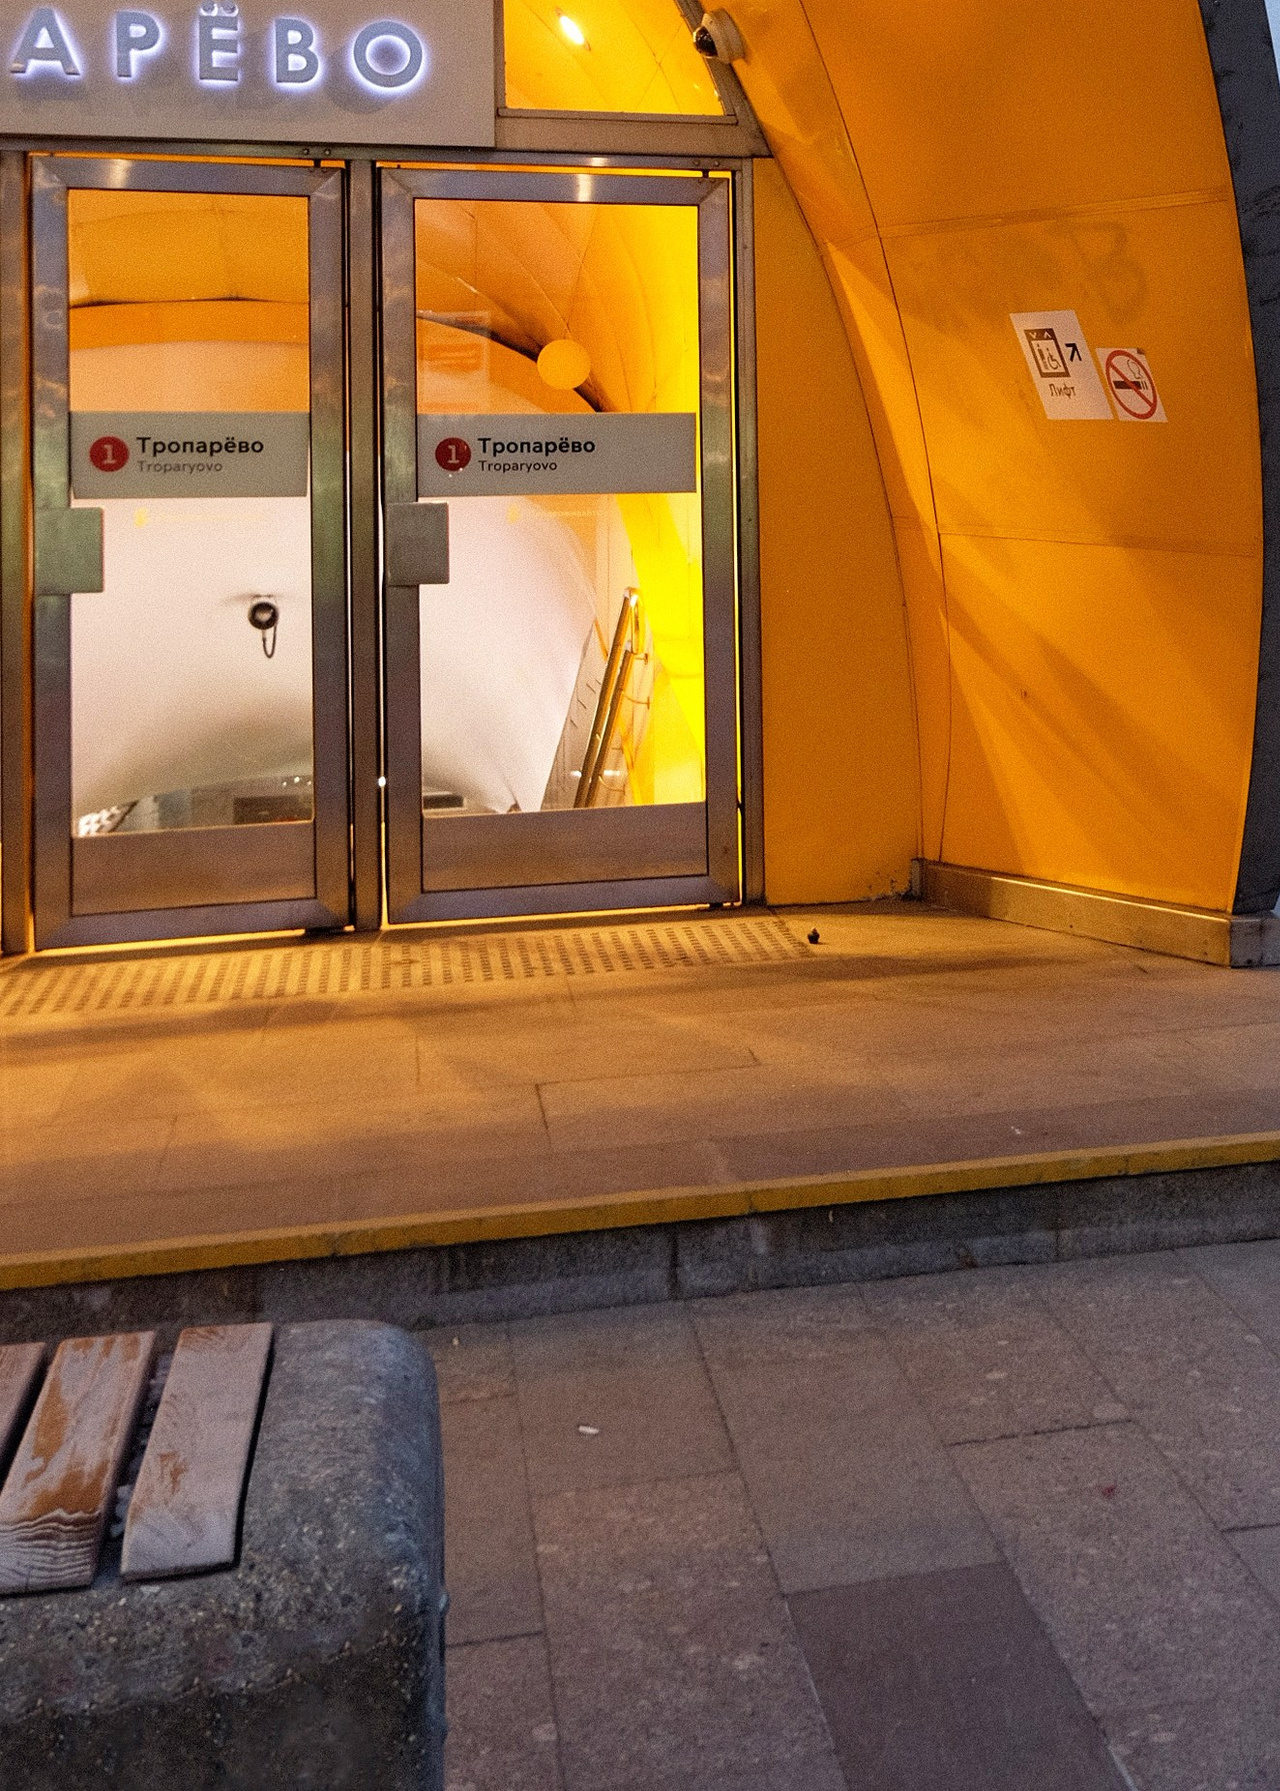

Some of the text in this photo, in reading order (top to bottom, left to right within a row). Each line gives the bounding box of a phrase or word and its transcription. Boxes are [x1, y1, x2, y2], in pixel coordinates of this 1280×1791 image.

[10, 0, 424, 89] АРЁВО
[1049, 383, 1077, 399] Лифт
[102, 444, 117, 464] 1
[136, 436, 264, 457] Тропарёво
[447, 444, 460, 464] 1
[477, 437, 596, 457] Тропарёво
[137, 460, 223, 474] Troparyovo
[478, 460, 558, 473] Troparyovo
